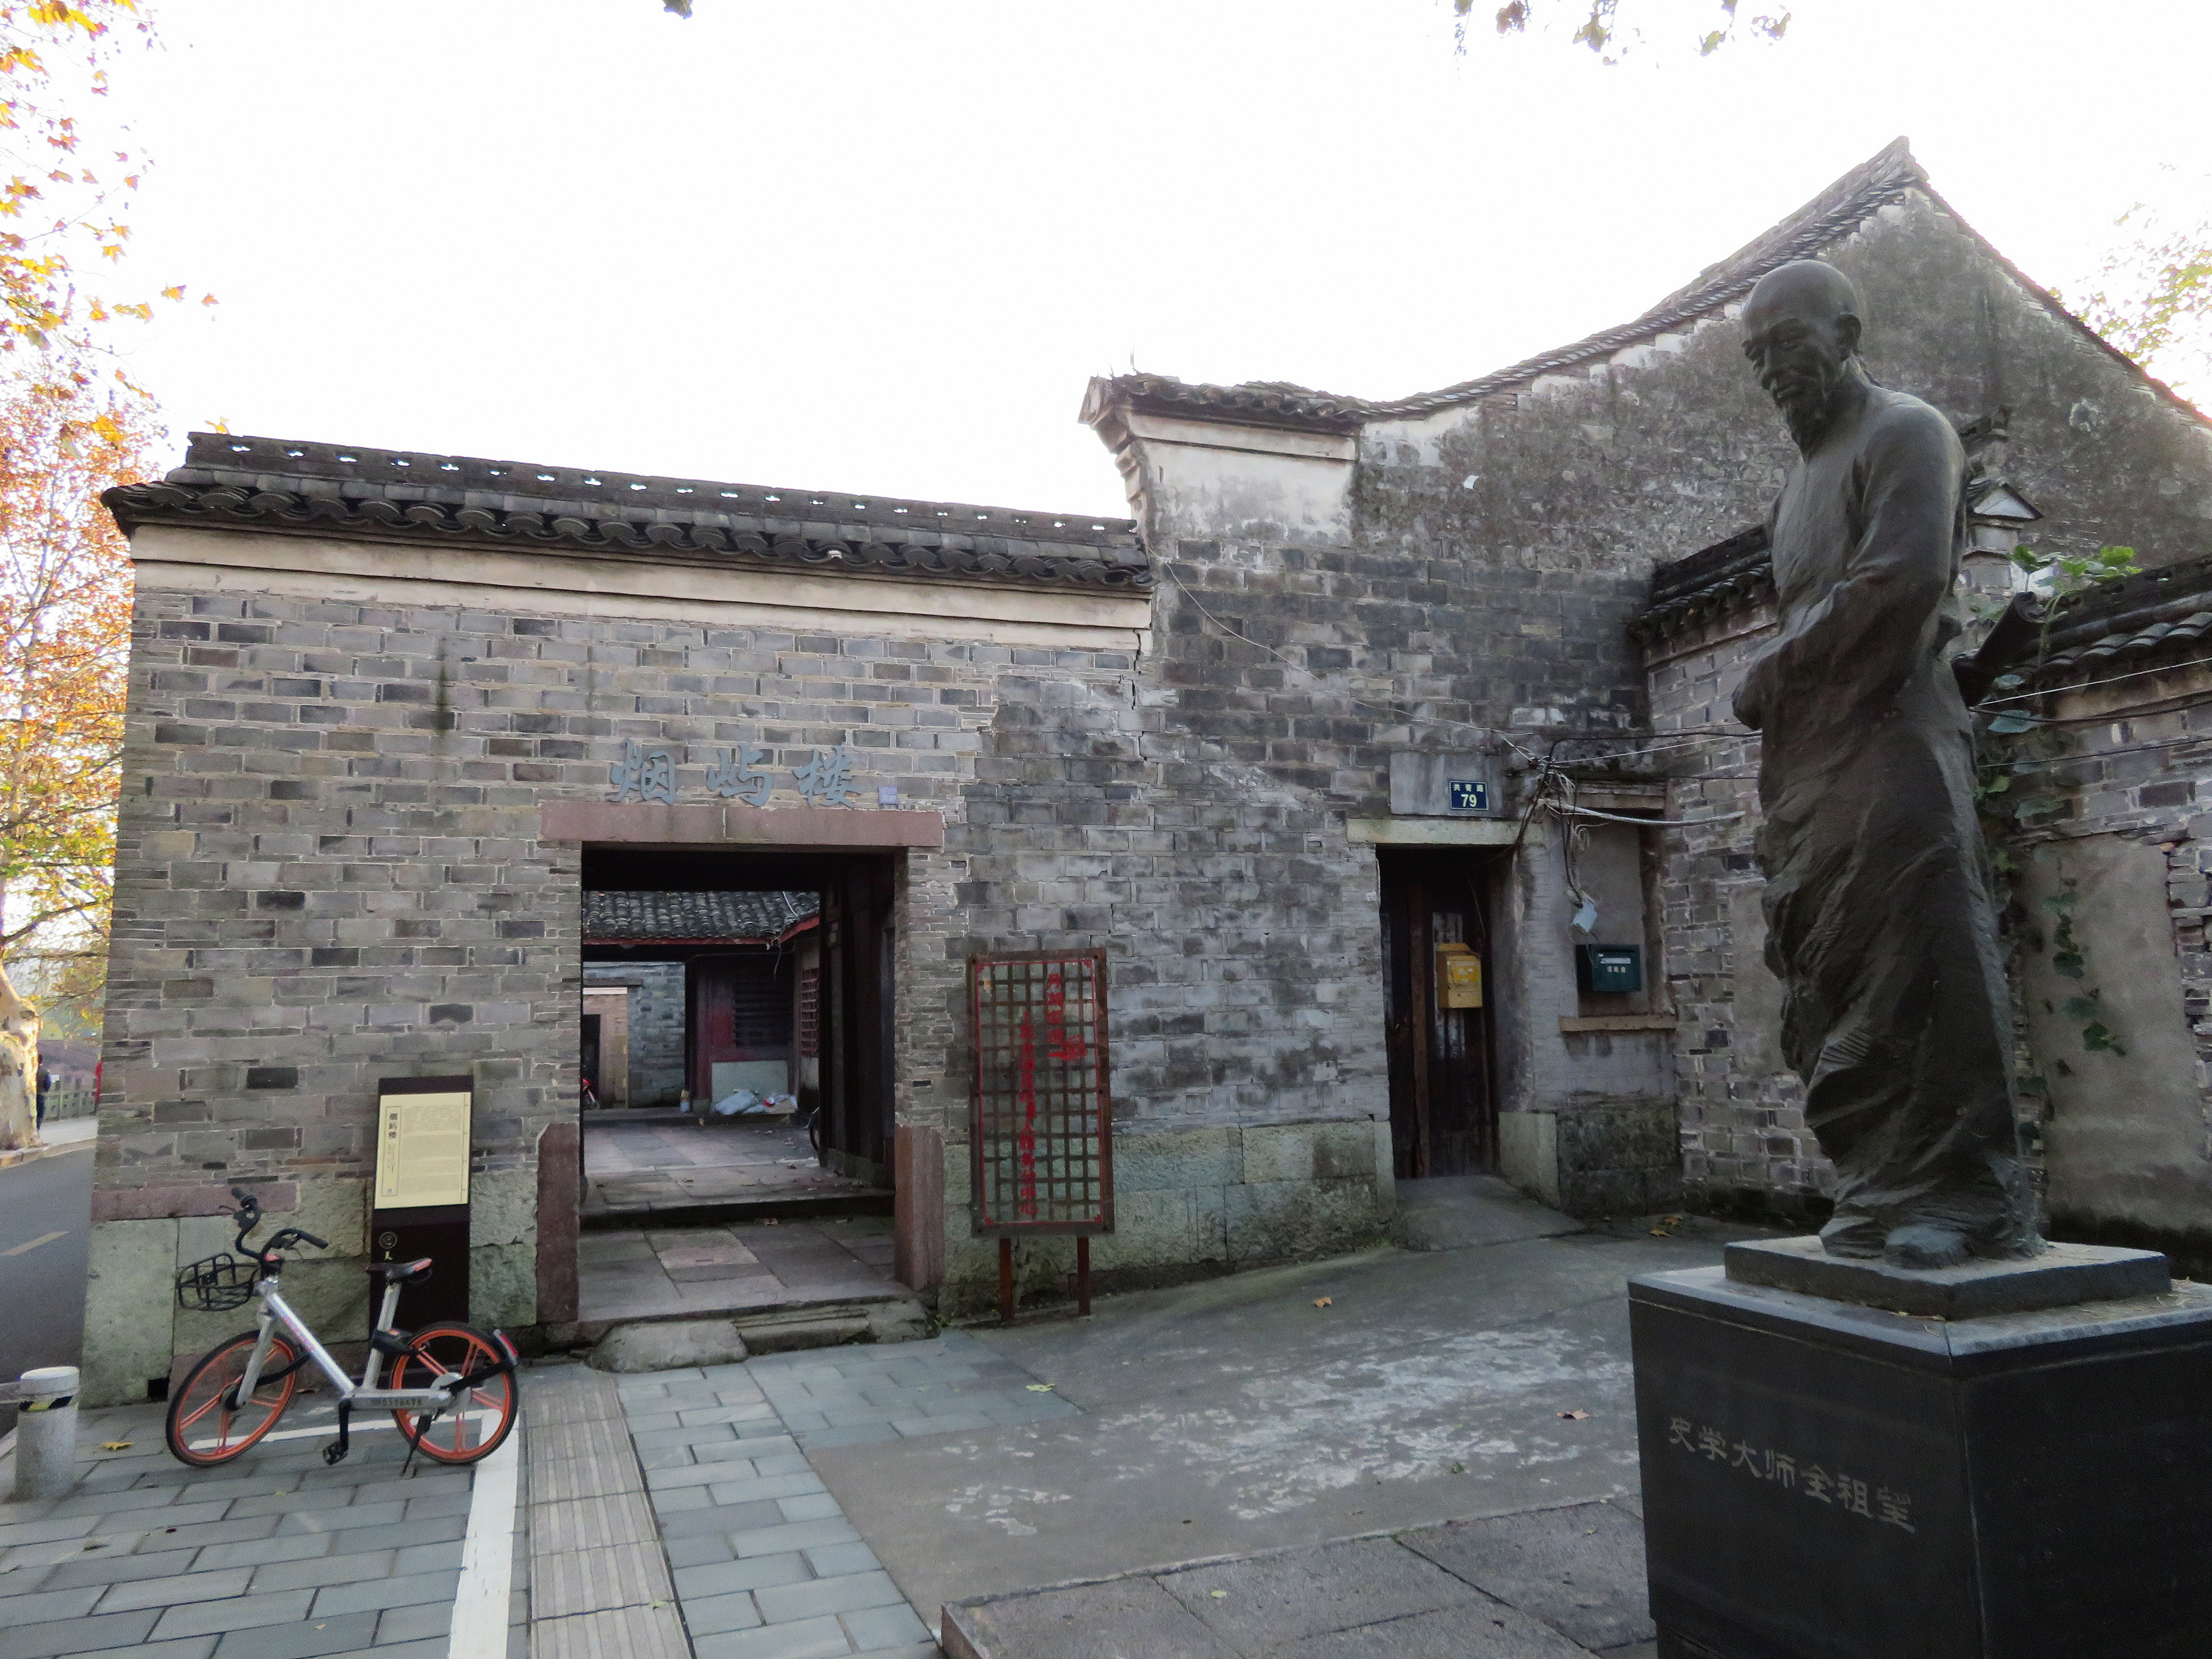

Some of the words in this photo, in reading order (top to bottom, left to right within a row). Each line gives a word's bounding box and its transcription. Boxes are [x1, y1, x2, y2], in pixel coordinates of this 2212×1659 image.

[611, 737, 860, 808] 烟屿楼
[1461, 794, 1477, 807] 79
[1669, 1416, 1915, 1534] 史学大师全祖望
